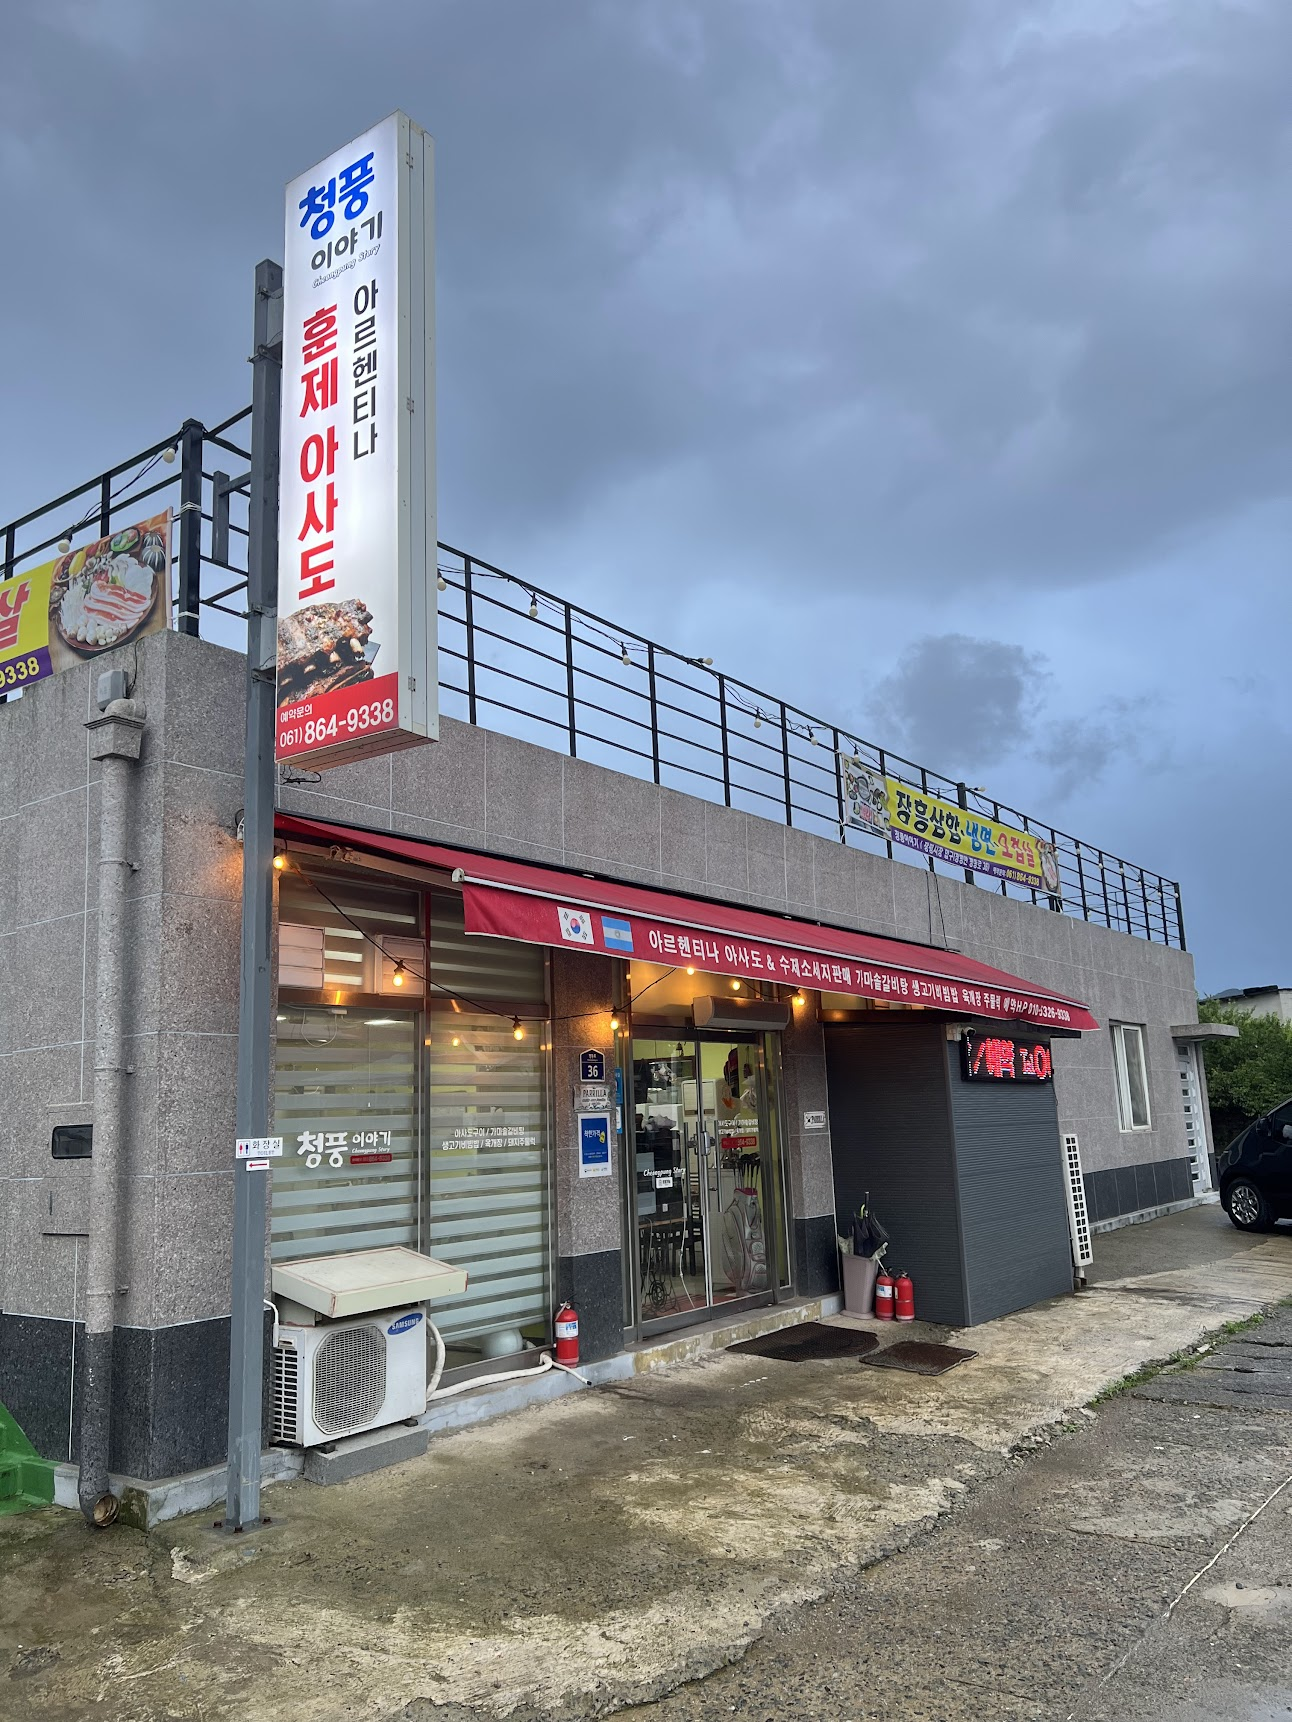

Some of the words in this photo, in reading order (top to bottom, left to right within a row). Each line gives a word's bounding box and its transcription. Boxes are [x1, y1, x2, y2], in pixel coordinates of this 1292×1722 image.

[299, 151, 375, 240] 청풍
[311, 210, 383, 271] 이야기
[358, 243, 381, 264] Story
[299, 303, 338, 418] 훈제
[352, 278, 379, 461] 아르헨티나
[297, 425, 338, 600] 아사도
[280, 703, 313, 724] 예약문의
[649, 929, 720, 964] 아르헨티나
[724, 944, 764, 969] 아사도
[766, 954, 776, 972] &
[855, 969, 909, 996] 가마솥갈비탕
[911, 979, 959, 1004] 생고기비빔밥
[587, 1064, 599, 1078] 36
[252, 1139, 280, 1150] 화장실
[296, 1130, 349, 1169] 청풍
[352, 1130, 392, 1147] 이야기
[391, 1317, 420, 1330] SAMSUNG
